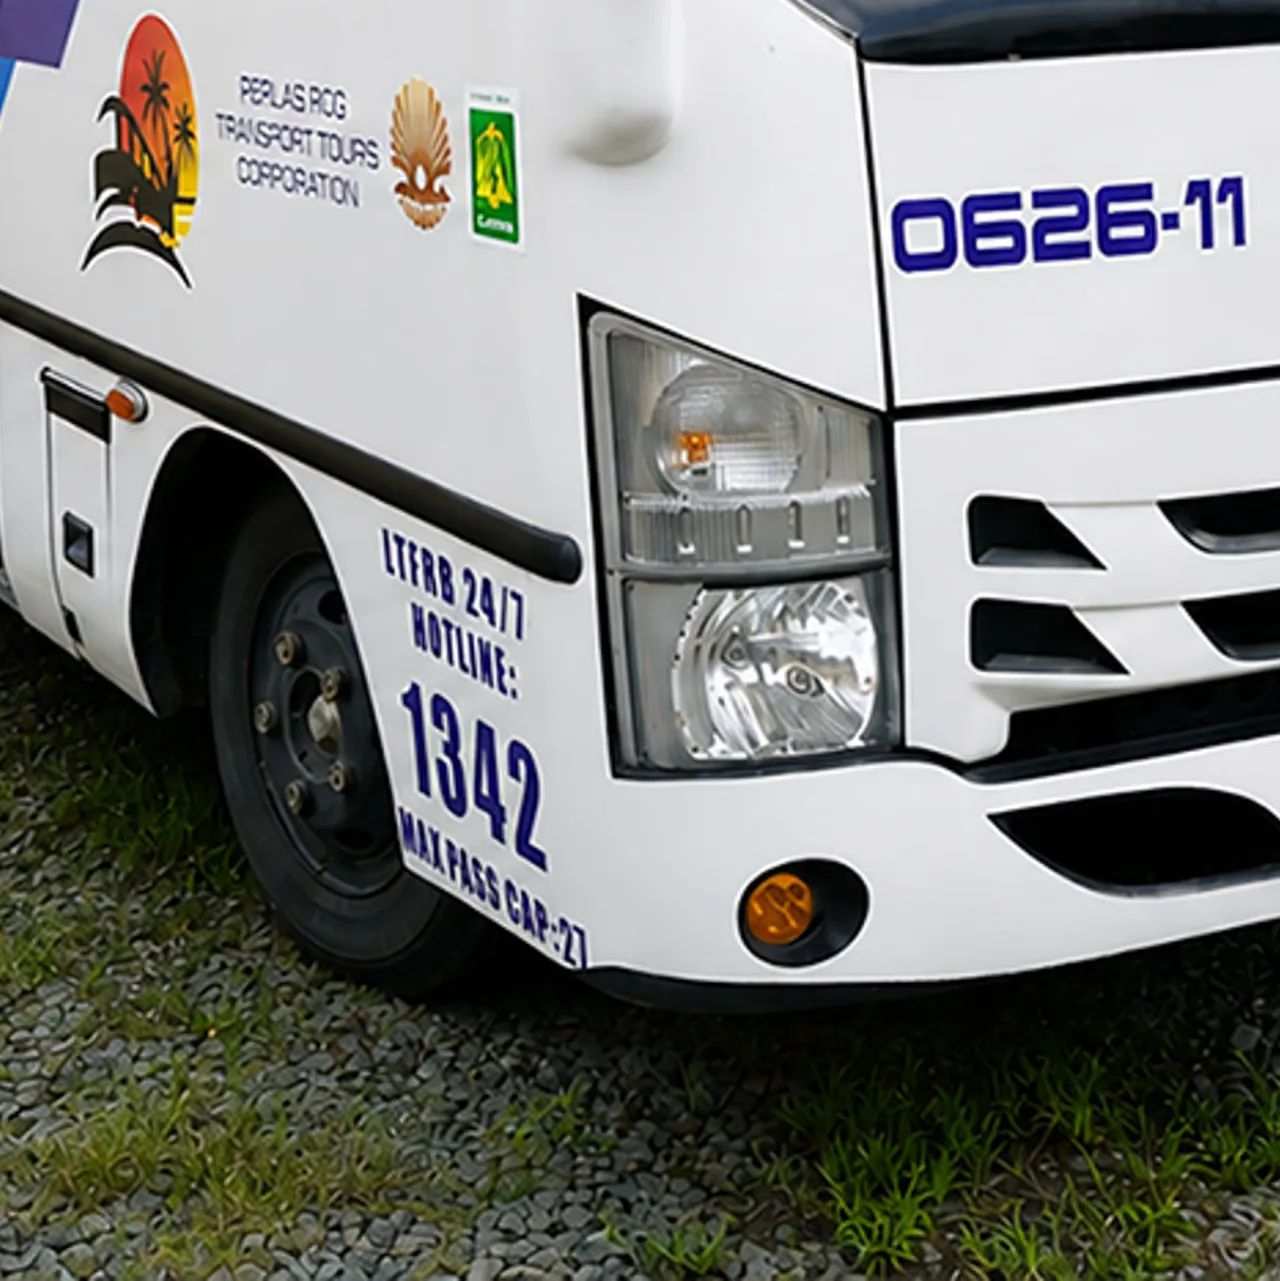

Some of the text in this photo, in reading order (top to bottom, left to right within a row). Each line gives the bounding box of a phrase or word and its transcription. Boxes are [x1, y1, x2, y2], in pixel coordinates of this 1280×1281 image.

[216, 112, 380, 170] TRANSPORT TOURS
[240, 75, 305, 113] PERLAS
[237, 156, 360, 208] CORPORATION
[891, 176, 1247, 274] 0626-11
[381, 527, 524, 641] LTFRB 24/7
[410, 601, 518, 700] HOTLINE:
[401, 681, 548, 872] 1342
[398, 806, 445, 875] MAX
[445, 837, 500, 911] PASS
